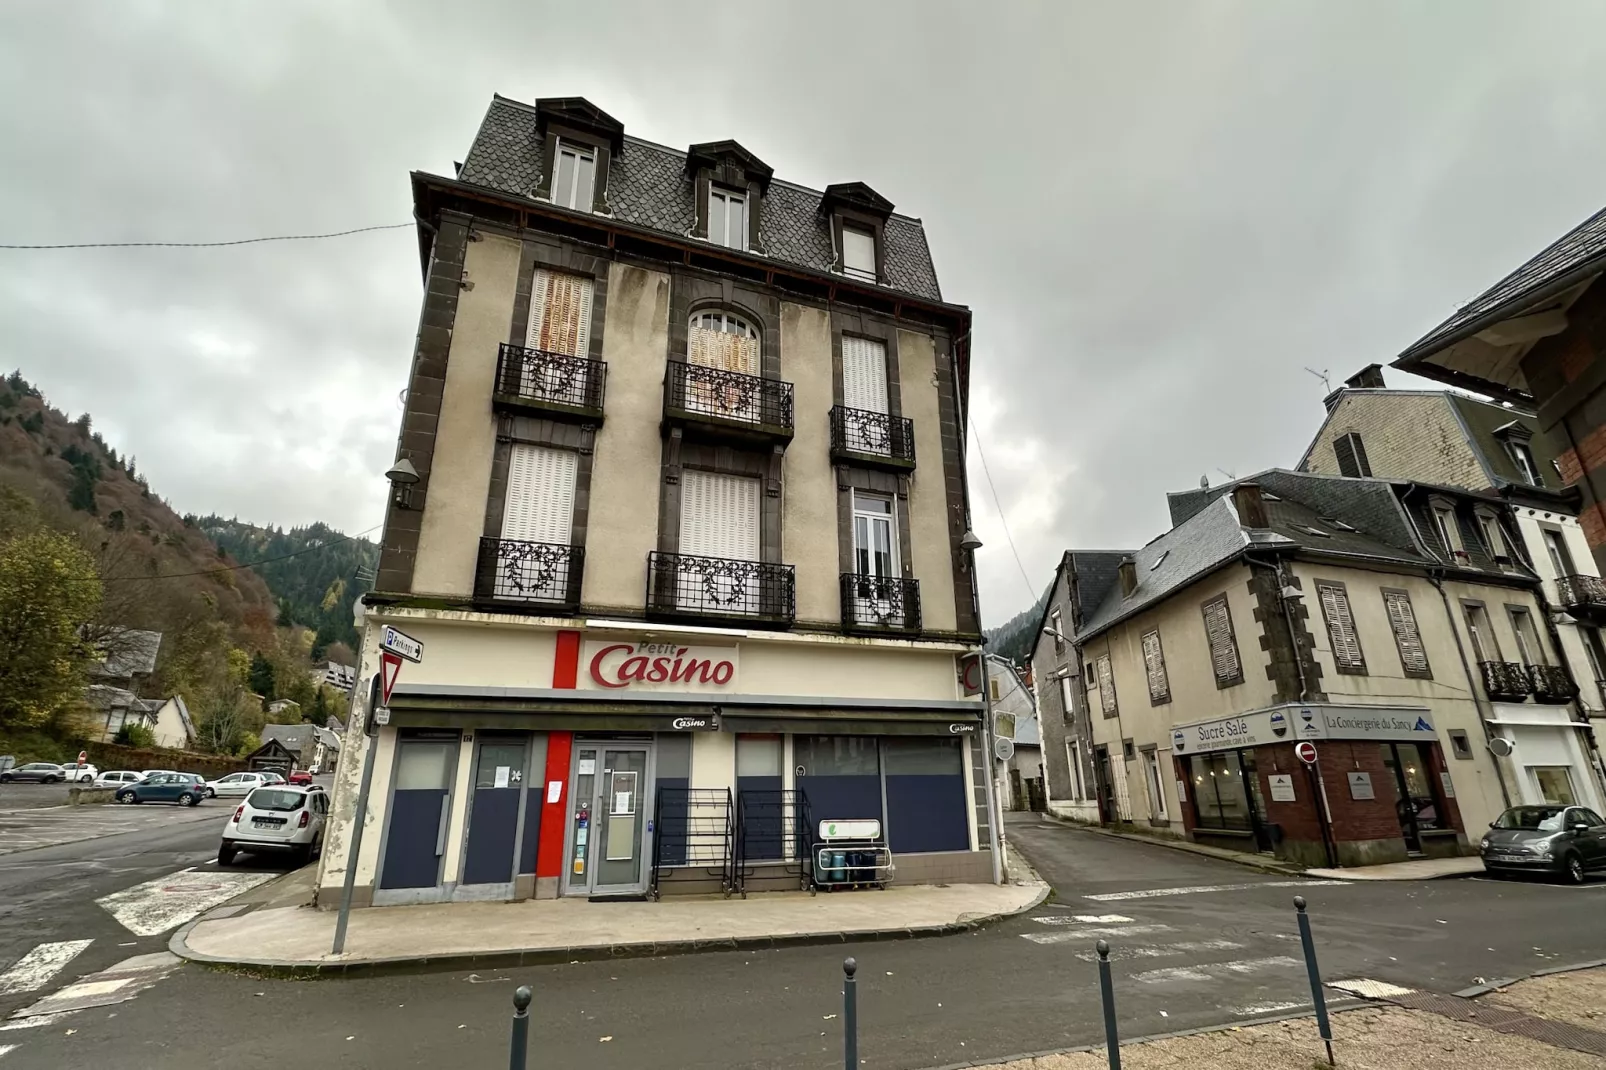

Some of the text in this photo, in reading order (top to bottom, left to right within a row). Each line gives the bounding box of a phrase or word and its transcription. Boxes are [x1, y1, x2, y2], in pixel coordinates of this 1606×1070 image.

[393, 635, 413, 655] Parkings
[637, 641, 677, 655] Petit
[590, 644, 734, 688] Casino
[672, 717, 706, 730] Casino
[949, 723, 974, 734] Casino
[1198, 719, 1248, 741] Sucré Salé
[1326, 716, 1412, 732] La Conciergerie du Sancy
